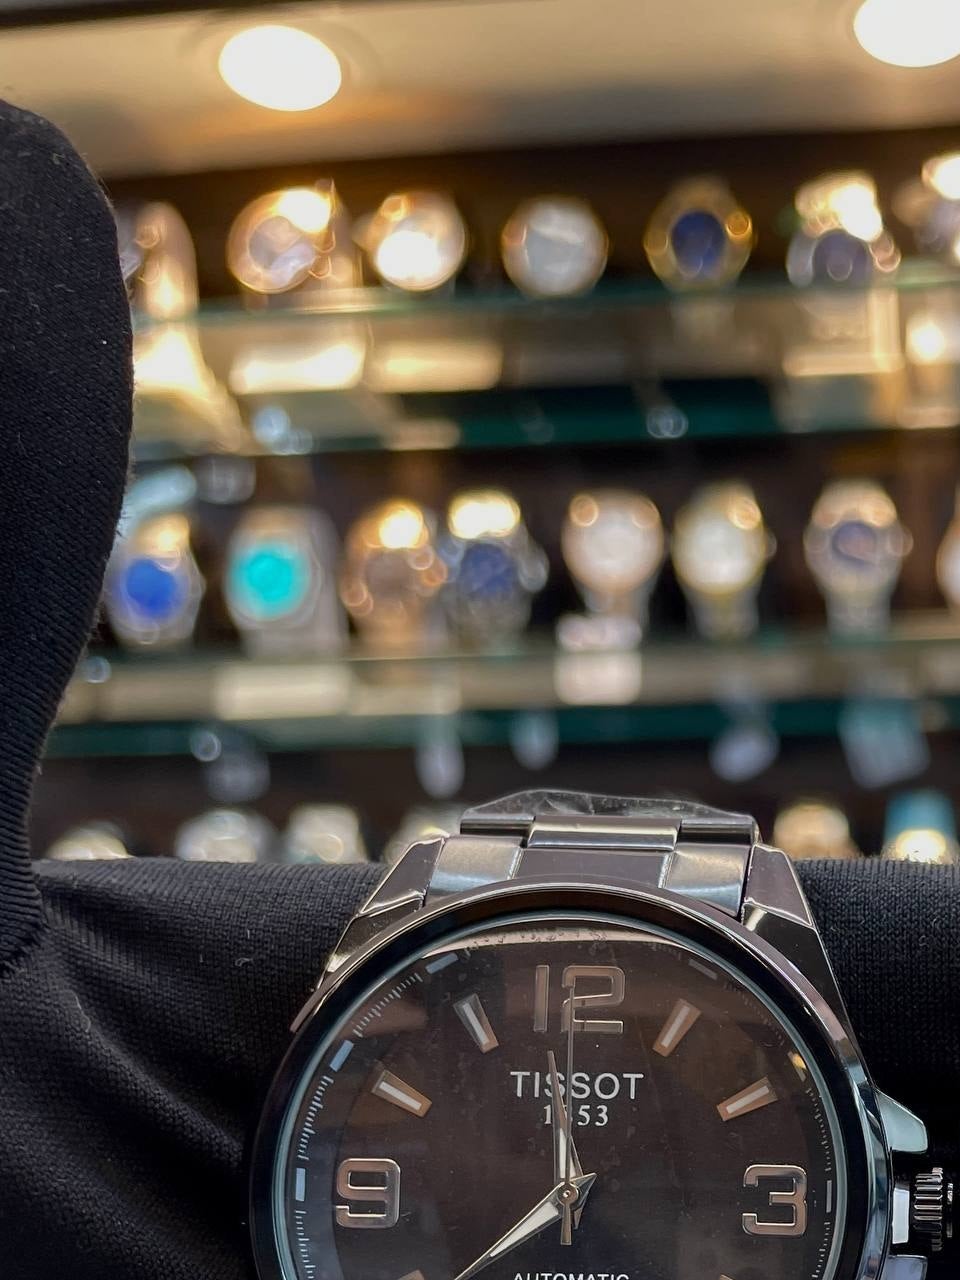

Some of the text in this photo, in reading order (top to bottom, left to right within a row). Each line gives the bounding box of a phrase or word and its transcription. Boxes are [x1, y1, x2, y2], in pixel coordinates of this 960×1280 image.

[533, 965, 626, 1034] 12
[510, 1071, 645, 1101] TISSOT
[543, 1104, 609, 1127] 153
[336, 1158, 401, 1229] 9
[742, 1163, 808, 1237] 3
